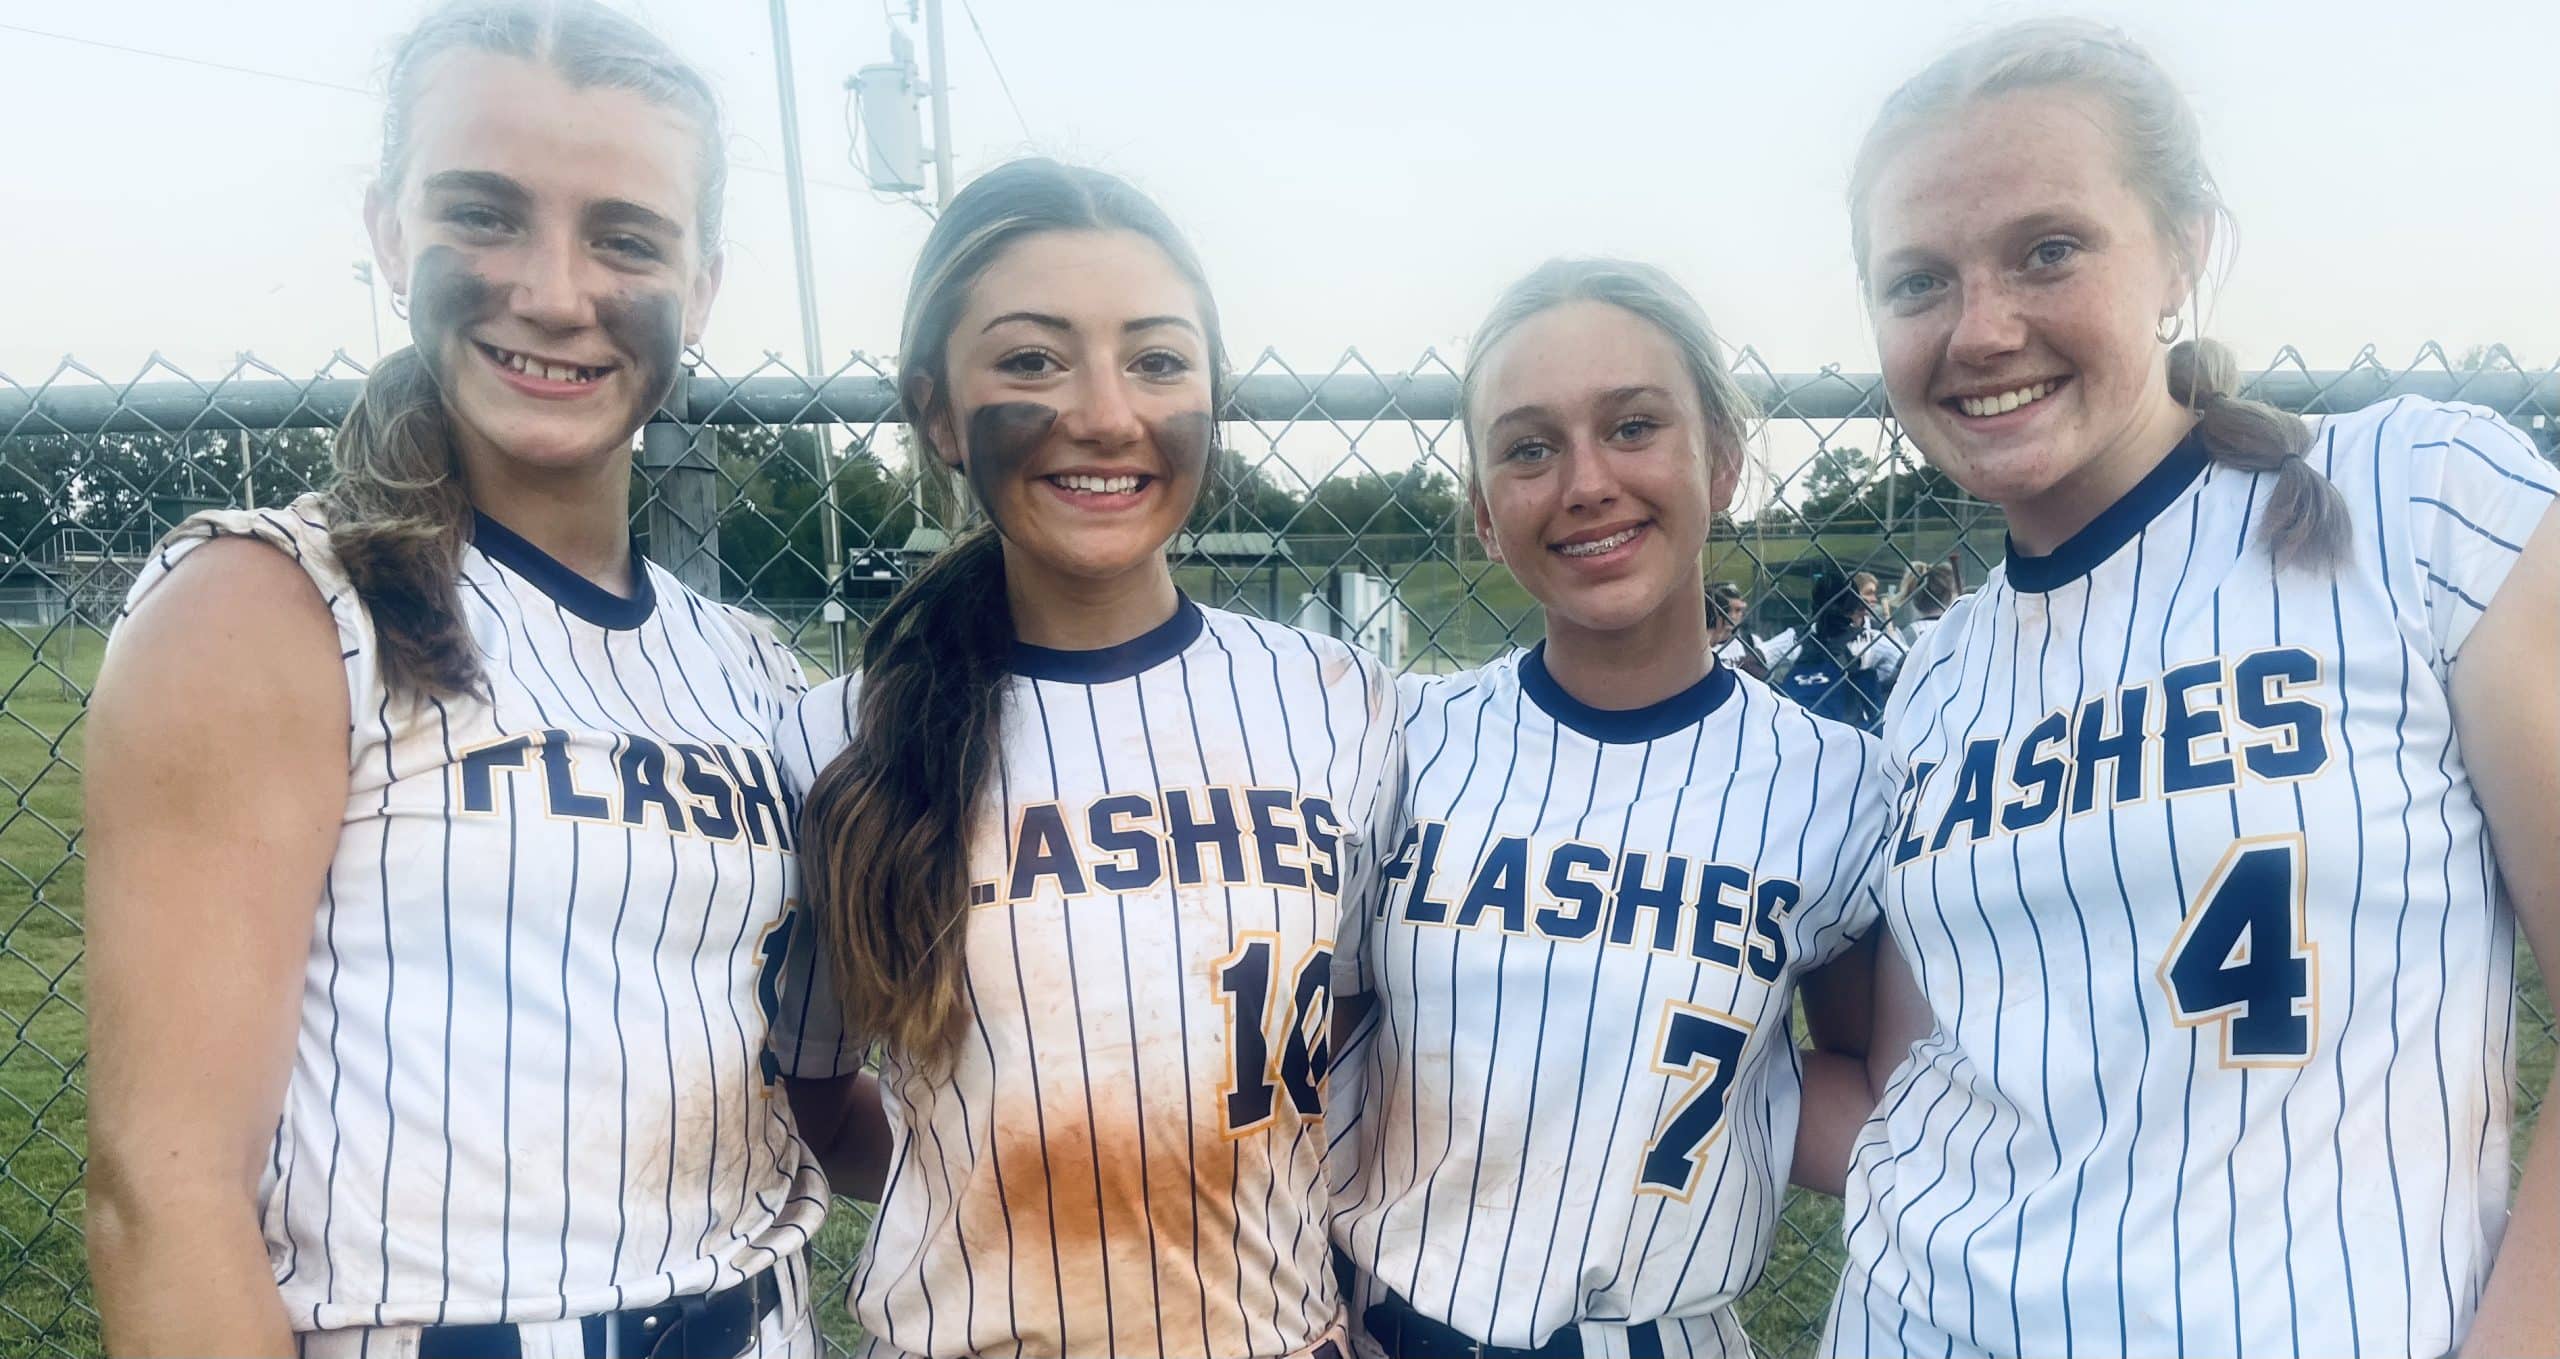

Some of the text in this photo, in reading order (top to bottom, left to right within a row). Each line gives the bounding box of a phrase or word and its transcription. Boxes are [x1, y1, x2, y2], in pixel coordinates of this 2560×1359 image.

[457, 728, 799, 856] FLASH
[970, 784, 1344, 910] ASHES
[1889, 645, 2334, 872] LASHES
[1375, 818, 1802, 986] FLASHES
[2155, 831, 2319, 1069] 4
[1210, 930, 1337, 1142] 10
[1633, 998, 1757, 1204] 7
